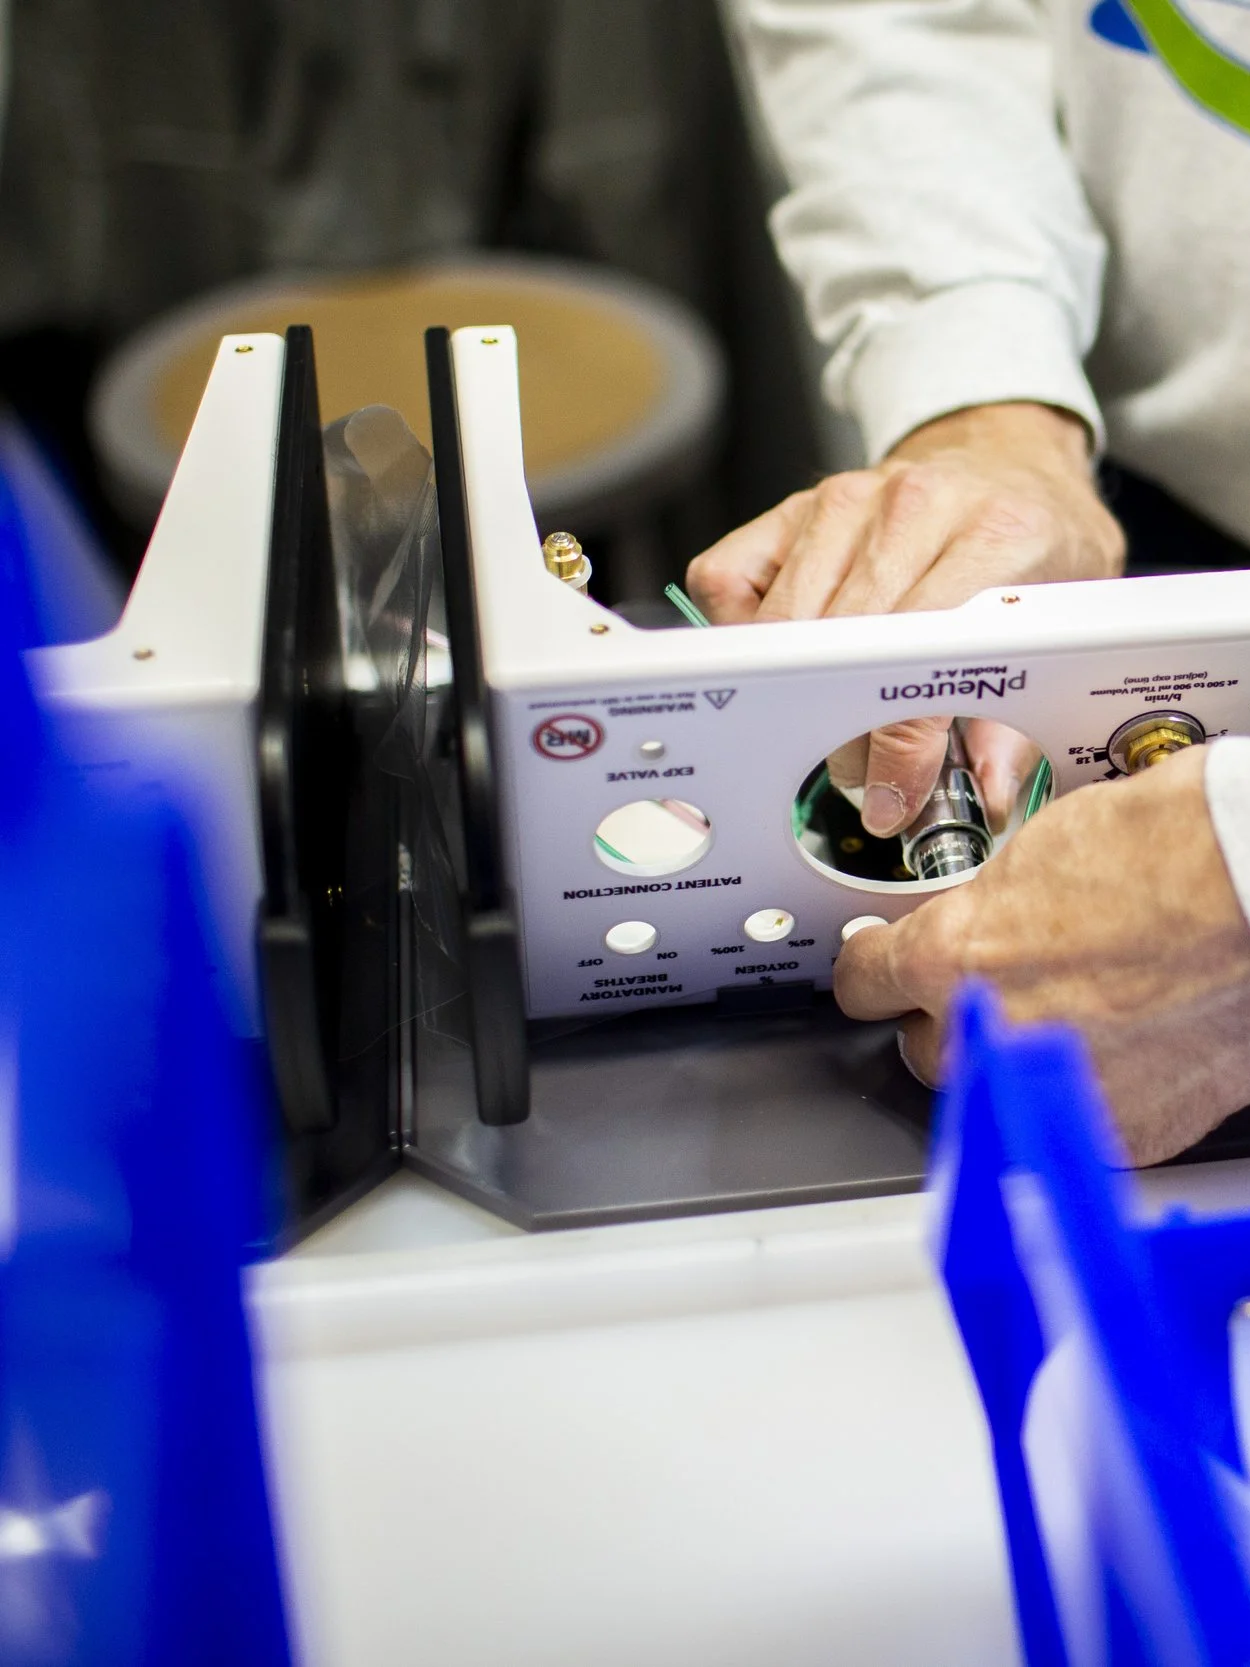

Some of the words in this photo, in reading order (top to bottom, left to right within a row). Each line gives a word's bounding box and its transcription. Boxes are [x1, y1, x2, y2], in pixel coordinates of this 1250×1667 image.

[962, 666, 1007, 677] Model
[1174, 672, 1208, 681] (adjust
[880, 670, 1026, 702] pNeuton
[1207, 681, 1225, 689] 500
[1090, 688, 1129, 697] Volume
[1131, 686, 1156, 695] Tidal
[1144, 693, 1182, 703] b/min
[1076, 757, 1091, 765] 18
[607, 771, 659, 782] VALVE
[663, 767, 694, 777] EXP
[676, 876, 741, 890] PATIENT
[564, 882, 672, 900] CONNECTION
[711, 945, 745, 955] 100%
[657, 951, 677, 961] ON
[577, 957, 603, 967] OFF
[735, 961, 799, 975] OXYGEN
[594, 973, 668, 988] BREATHS
[580, 984, 683, 1002] MANDATORY
